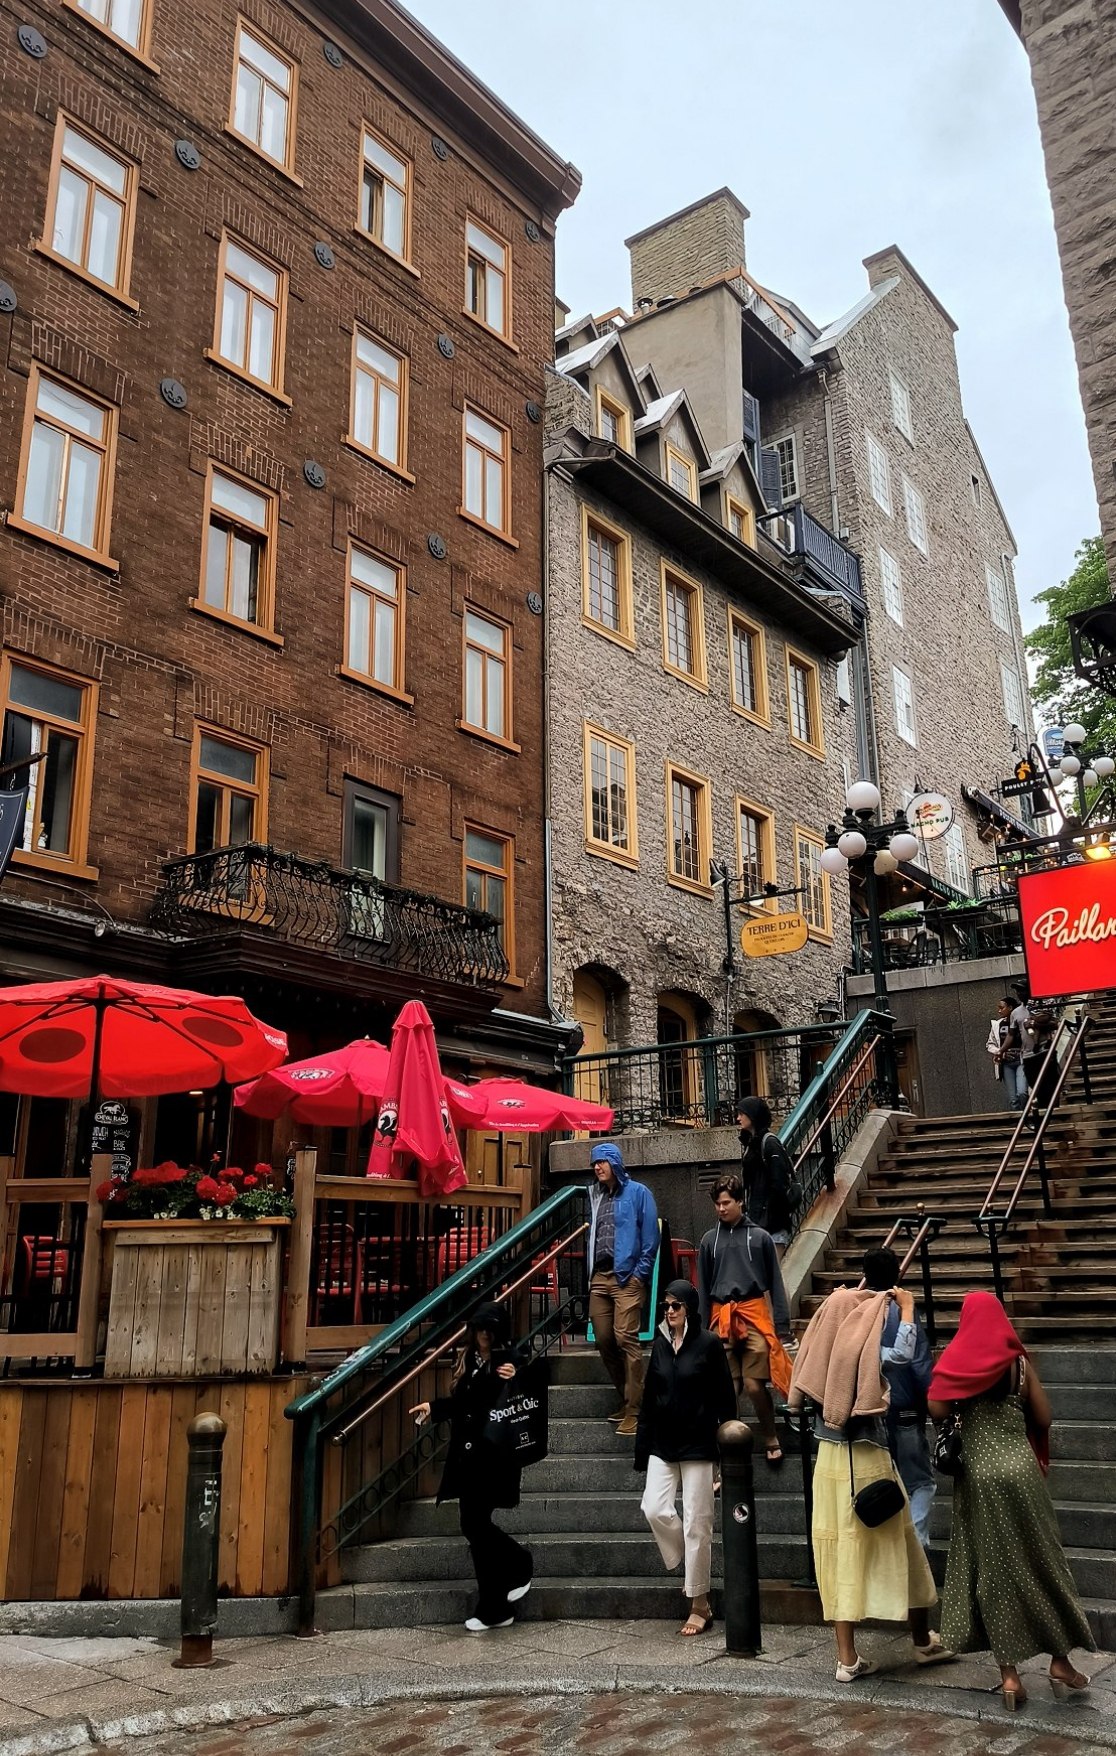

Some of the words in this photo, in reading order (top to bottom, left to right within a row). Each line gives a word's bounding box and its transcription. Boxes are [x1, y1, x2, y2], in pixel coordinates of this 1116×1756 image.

[911, 820, 934, 828] NACHO
[747, 922, 777, 936] TERRE
[779, 919, 800, 930] D'ICI
[489, 1405, 517, 1423] Sport
[517, 1403, 523, 1412] &
[522, 1397, 539, 1410] Chic
